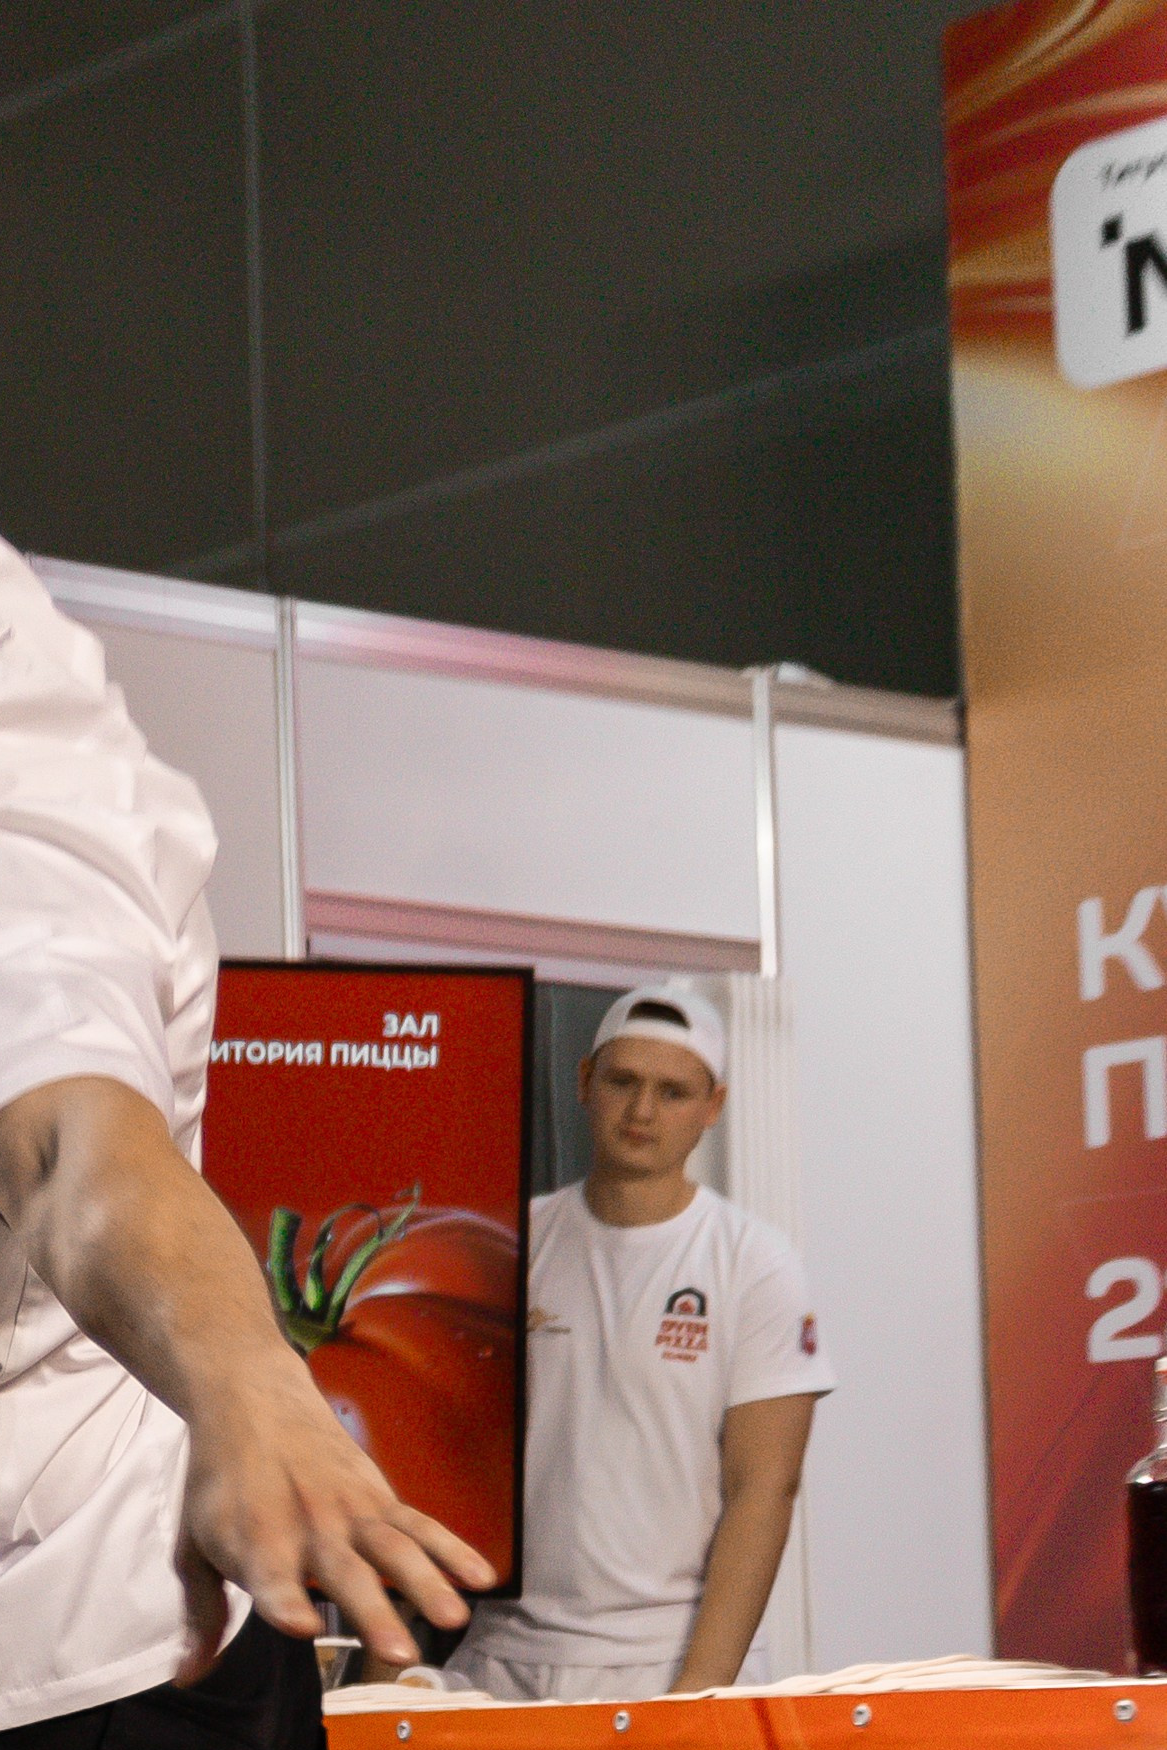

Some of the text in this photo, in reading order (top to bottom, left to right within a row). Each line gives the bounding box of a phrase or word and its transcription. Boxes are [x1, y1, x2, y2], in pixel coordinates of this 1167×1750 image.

[1077, 885, 1167, 1001] К
[210, 1040, 439, 1071] ИТОРИЯ ПИЦЦЫ
[383, 1012, 439, 1038] ЗАЛ
[1086, 1256, 1167, 1364] 2
